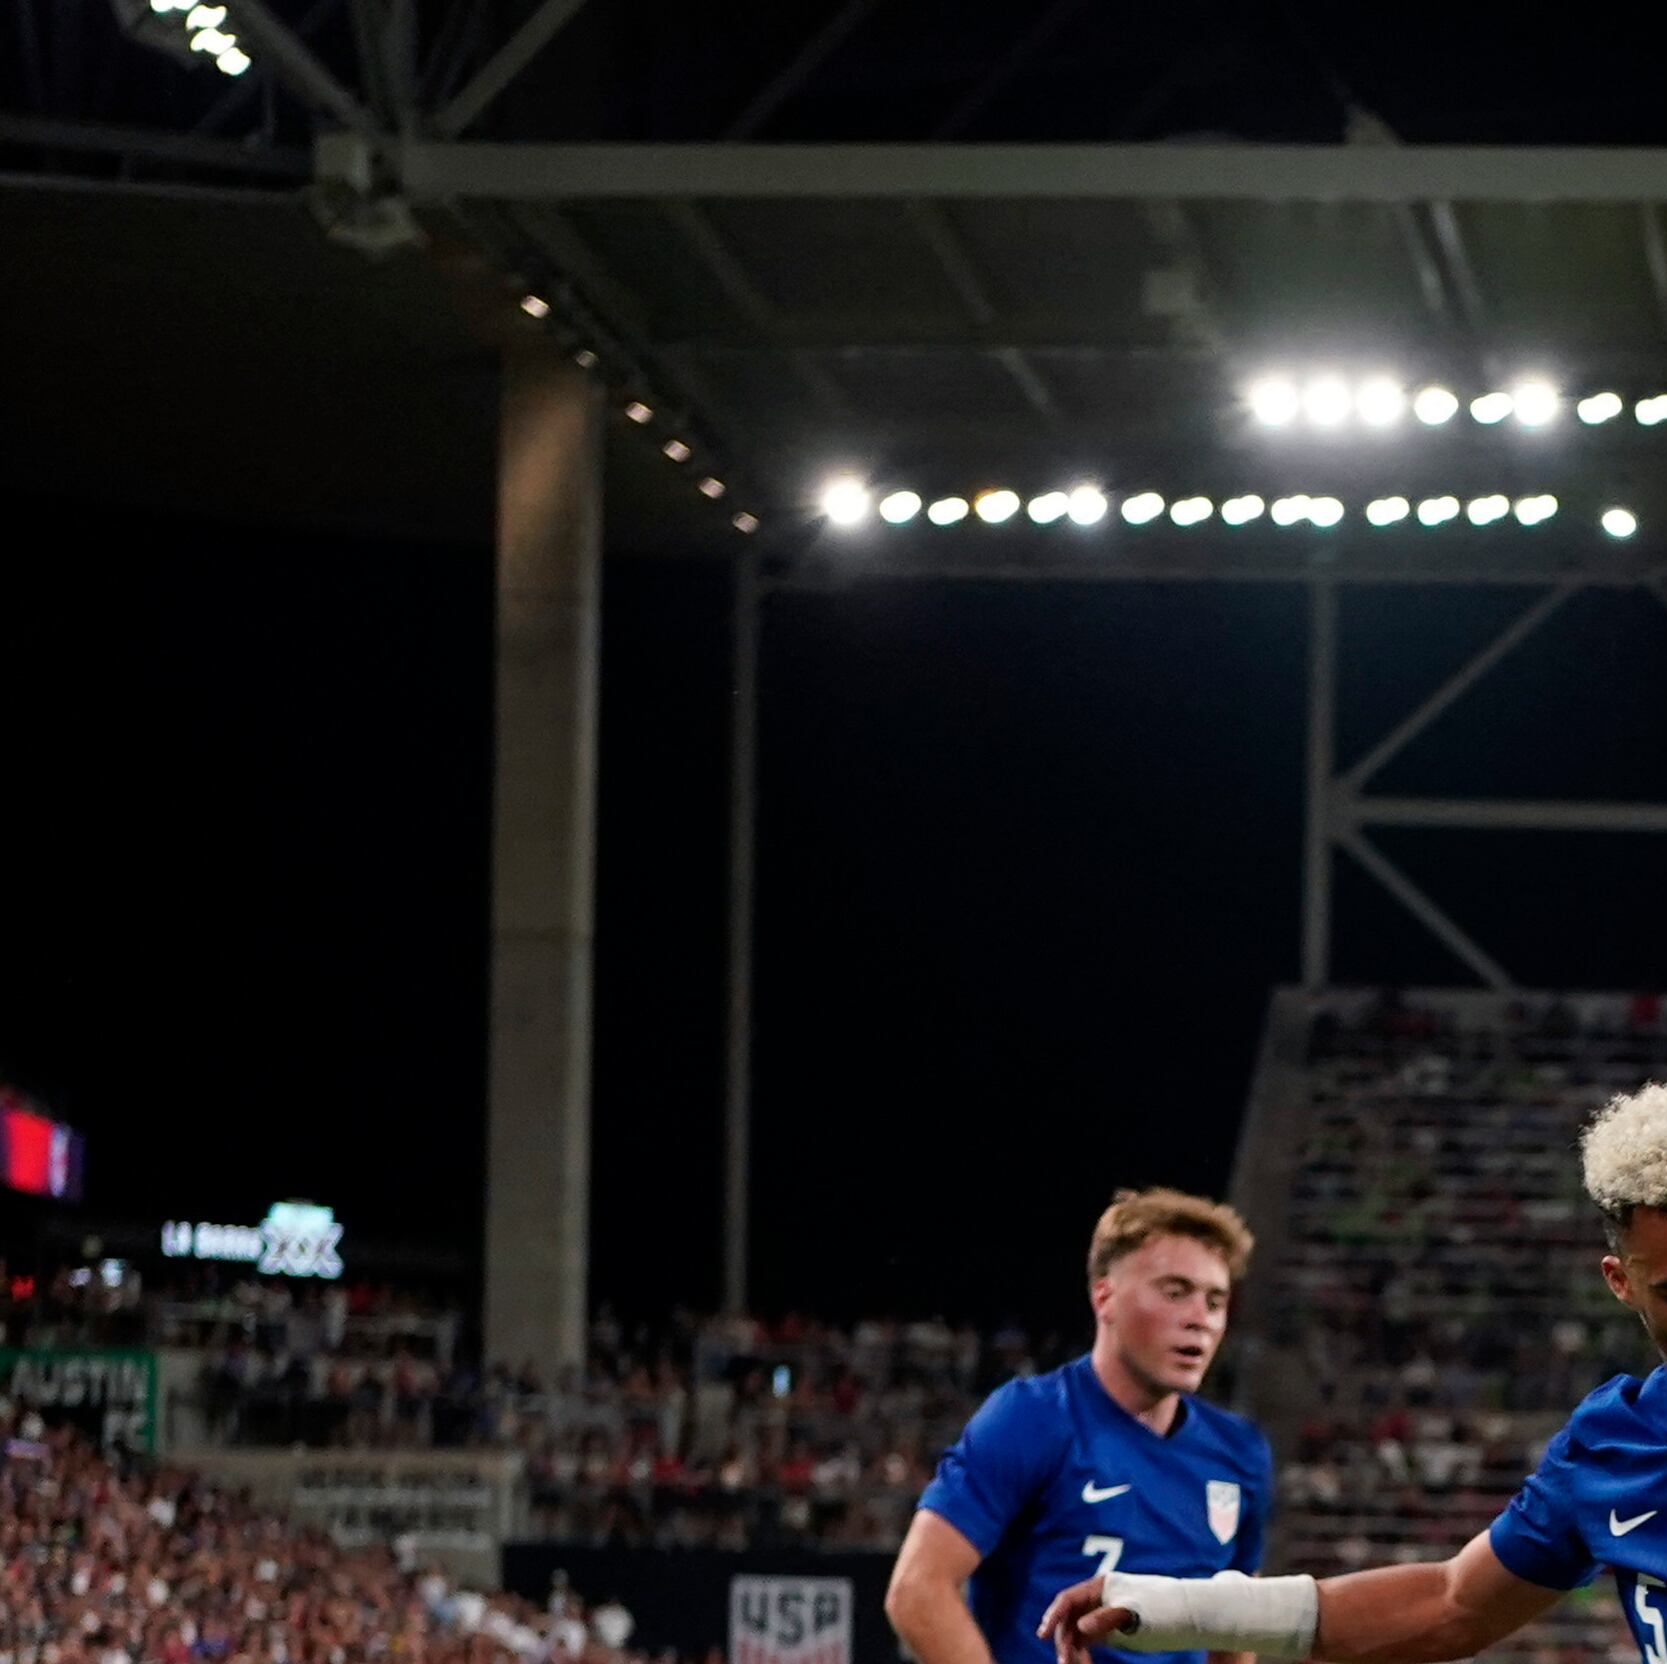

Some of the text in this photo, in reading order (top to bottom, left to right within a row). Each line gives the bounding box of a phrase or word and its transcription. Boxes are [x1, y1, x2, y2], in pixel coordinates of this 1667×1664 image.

[11, 1355, 149, 1406] AUSTIN
[1082, 1534, 1124, 1576] 7
[740, 1591, 841, 1646] USA
